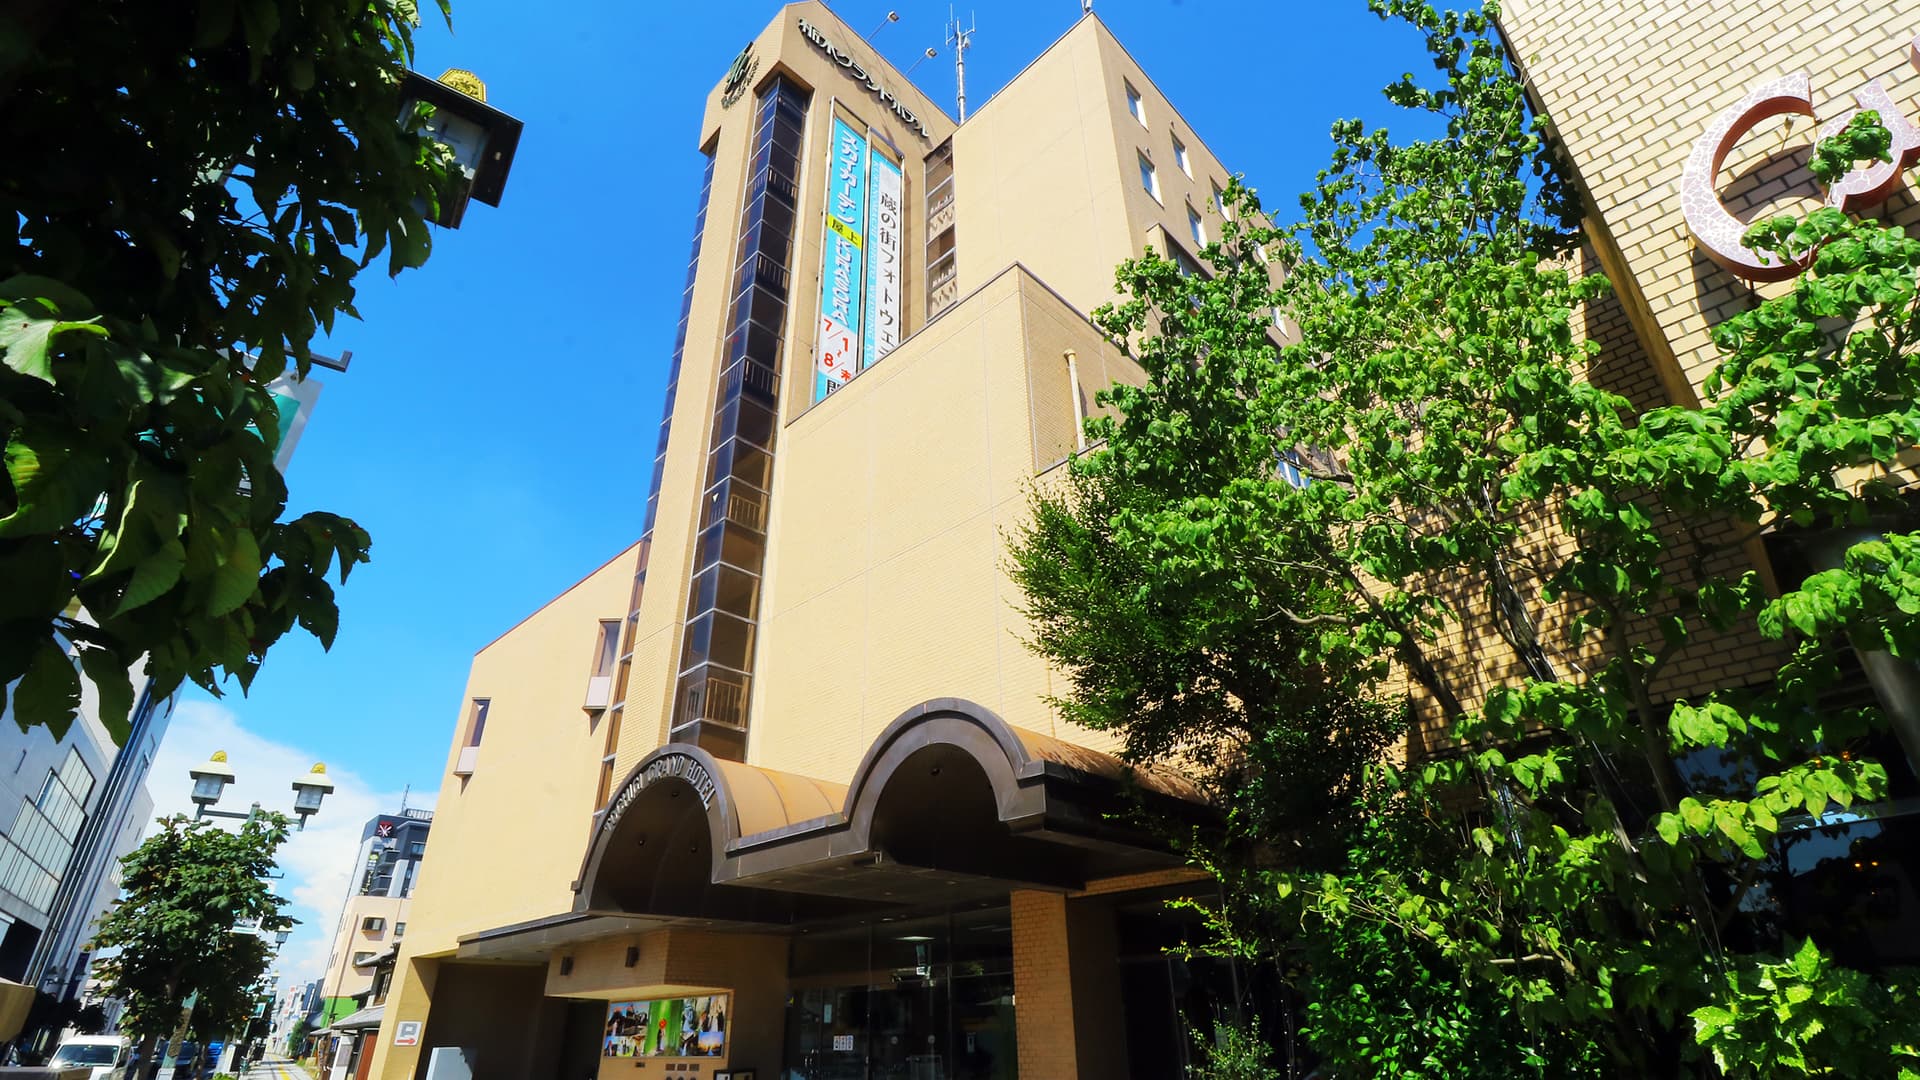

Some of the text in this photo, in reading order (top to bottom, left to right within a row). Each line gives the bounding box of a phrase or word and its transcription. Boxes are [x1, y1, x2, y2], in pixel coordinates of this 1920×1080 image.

[1681, 36, 1920, 282] Ca
[648, 755, 685, 783] GRAND
[686, 759, 715, 812] HOTEL
